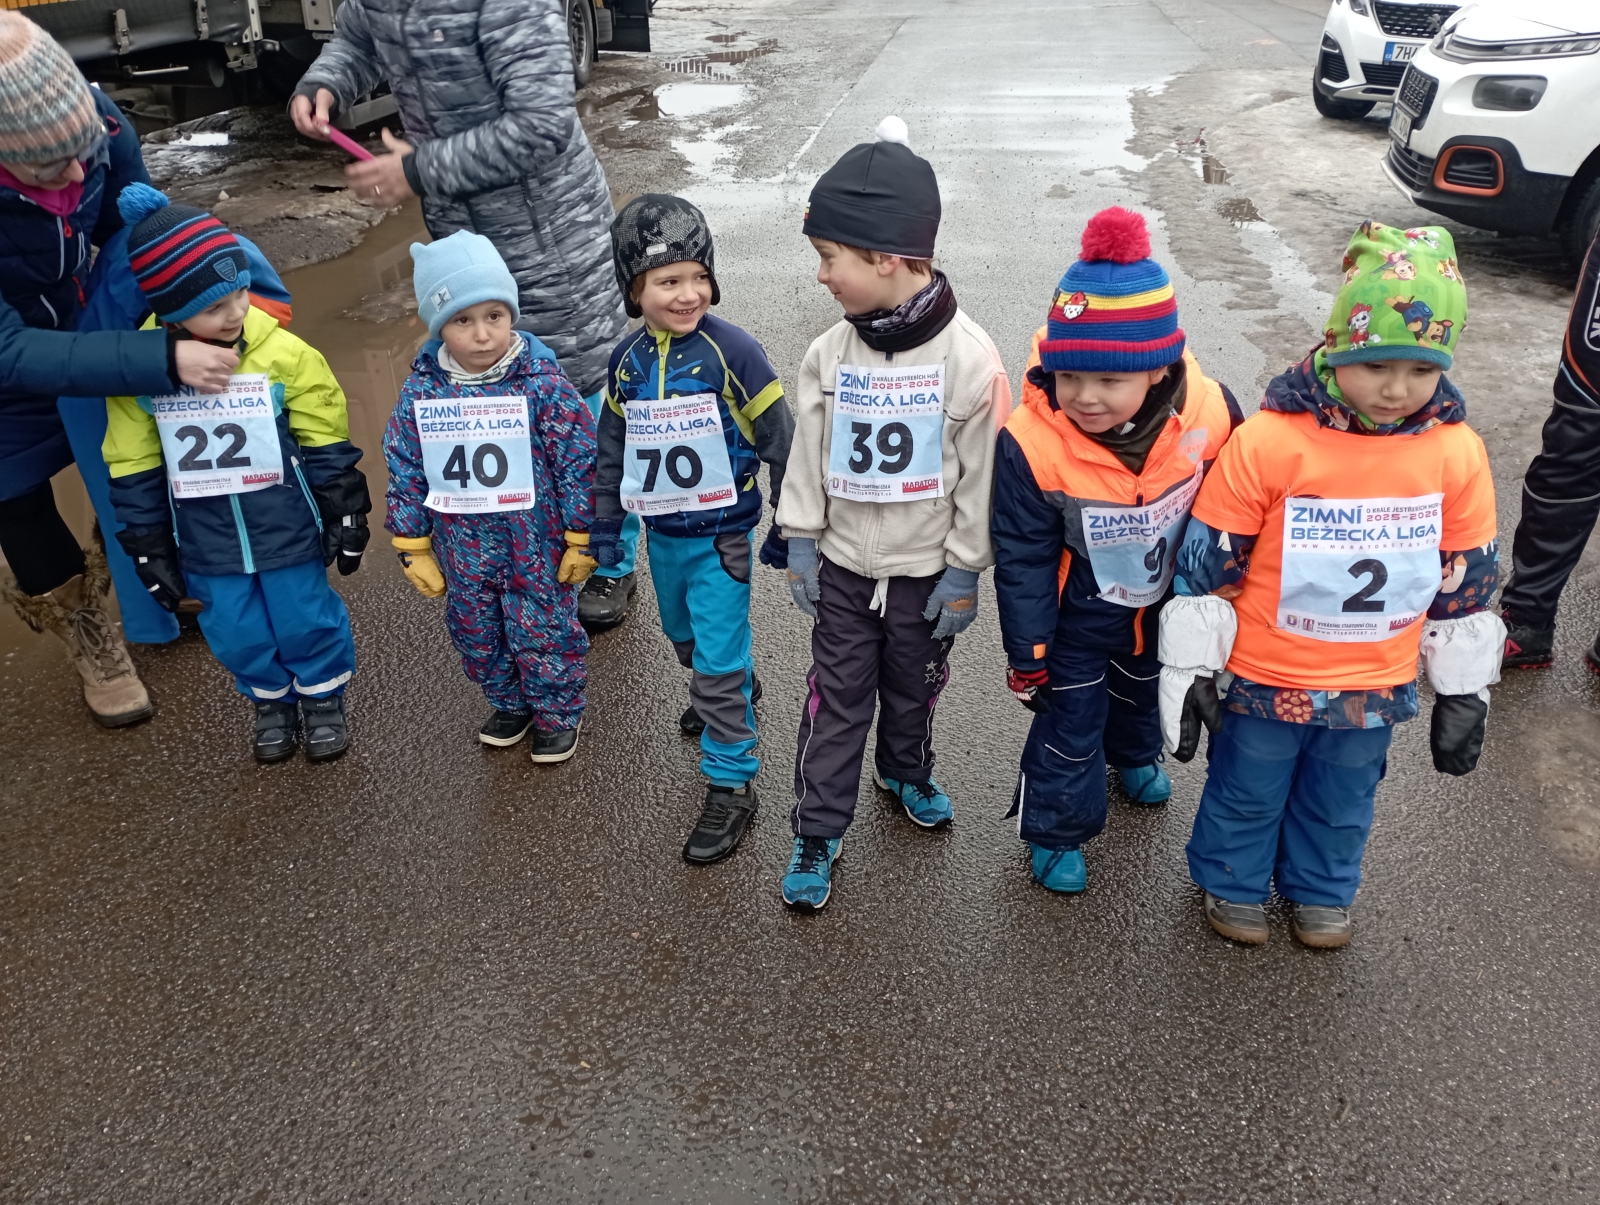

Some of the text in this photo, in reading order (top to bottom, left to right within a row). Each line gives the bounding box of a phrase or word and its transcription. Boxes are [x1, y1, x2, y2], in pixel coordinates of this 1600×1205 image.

[872, 380, 939, 389] 2025-2026
[153, 397, 267, 413] BĚŽECKÁ LIGA
[900, 393, 940, 406] LIGA
[420, 403, 461, 419] ZIMNÍ
[463, 408, 522, 416] 2025-2026
[626, 406, 651, 421] ZIMNÍ
[653, 406, 713, 419] 2025-2026
[421, 418, 524, 432] BĚŽECKÁ LIGA
[628, 417, 716, 434] BĚŽECKÁ LIGA
[174, 423, 251, 471] 22
[848, 421, 914, 474] 39
[442, 443, 508, 488] 40
[636, 445, 703, 492] 70
[242, 472, 280, 481] MARATON
[902, 478, 938, 488] MARATON
[698, 488, 732, 499] MARATON
[1088, 510, 1150, 528] ZIMNÍ
[1292, 505, 1363, 524] ZIMNÍ
[1367, 510, 1438, 522] 2025-2026
[1090, 514, 1170, 541] BĚŽECKÁ
[1291, 524, 1437, 541] BĚŽECKÁ LIGA
[1144, 537, 1167, 583] 9
[1342, 559, 1388, 612] 2
[1390, 614, 1423, 628] MARAT
